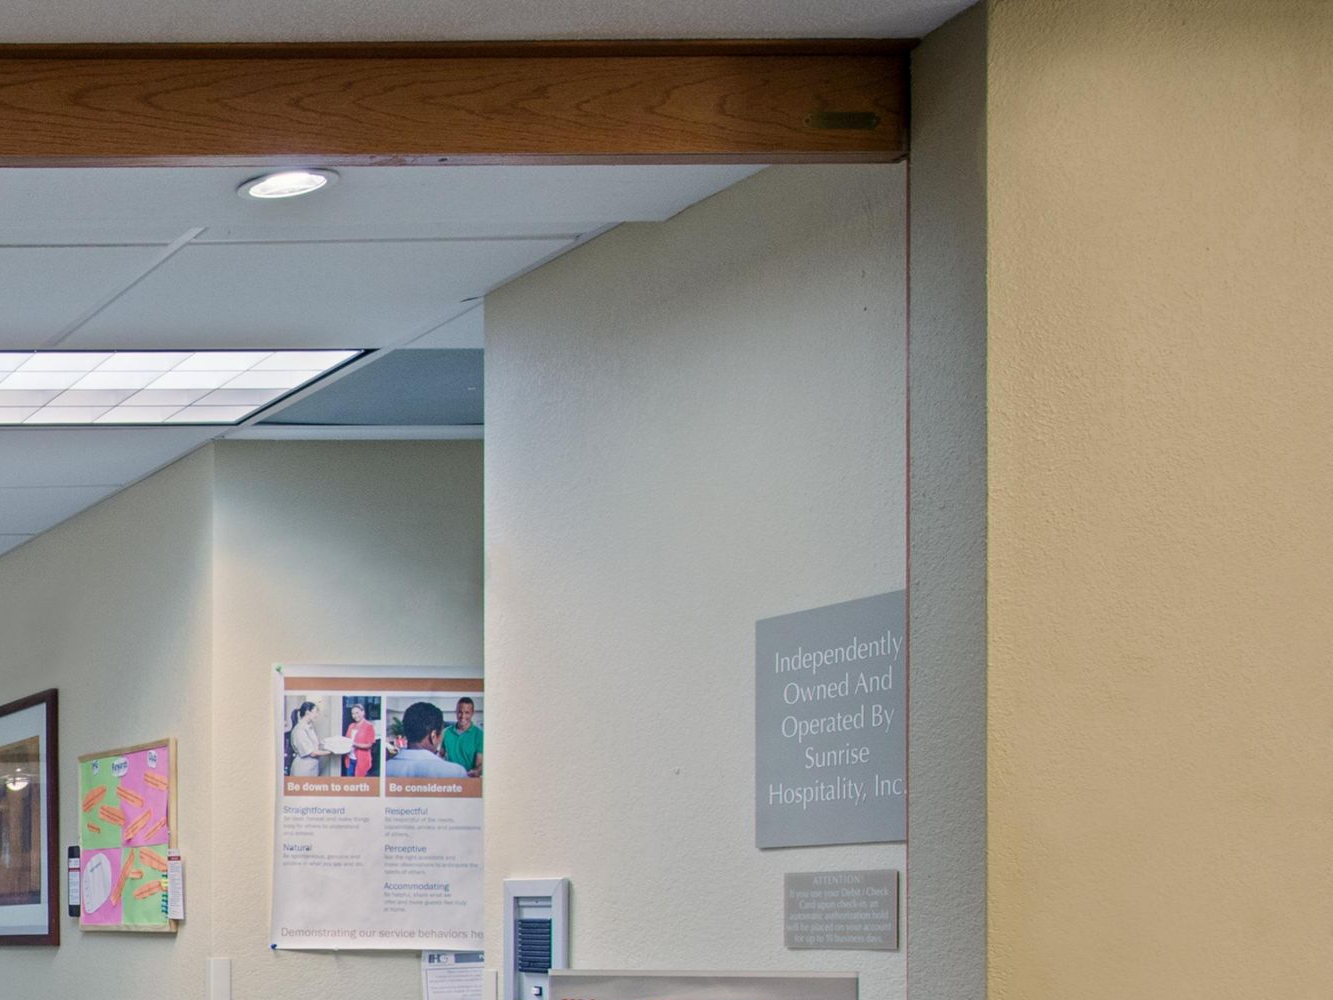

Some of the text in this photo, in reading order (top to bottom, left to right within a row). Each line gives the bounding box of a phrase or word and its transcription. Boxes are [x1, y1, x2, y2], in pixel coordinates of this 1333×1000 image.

[774, 630, 903, 675] Independently
[784, 665, 893, 705] Owned And
[781, 704, 895, 743] Operated By
[805, 743, 869, 769] Sunrise
[287, 782, 370, 792] Be down to earth
[389, 783, 463, 793] Be considerate
[768, 773, 907, 810] Hospitality, Inc.
[283, 805, 346, 815] Straightforward
[385, 807, 428, 816] Respectful
[283, 844, 312, 852] Natural
[385, 845, 427, 853] Perceptive
[384, 882, 450, 892] Accommodating
[281, 927, 357, 940] Demonstrating
[358, 929, 378, 938] our
[379, 928, 416, 938] service
[418, 928, 469, 939] behaviors
